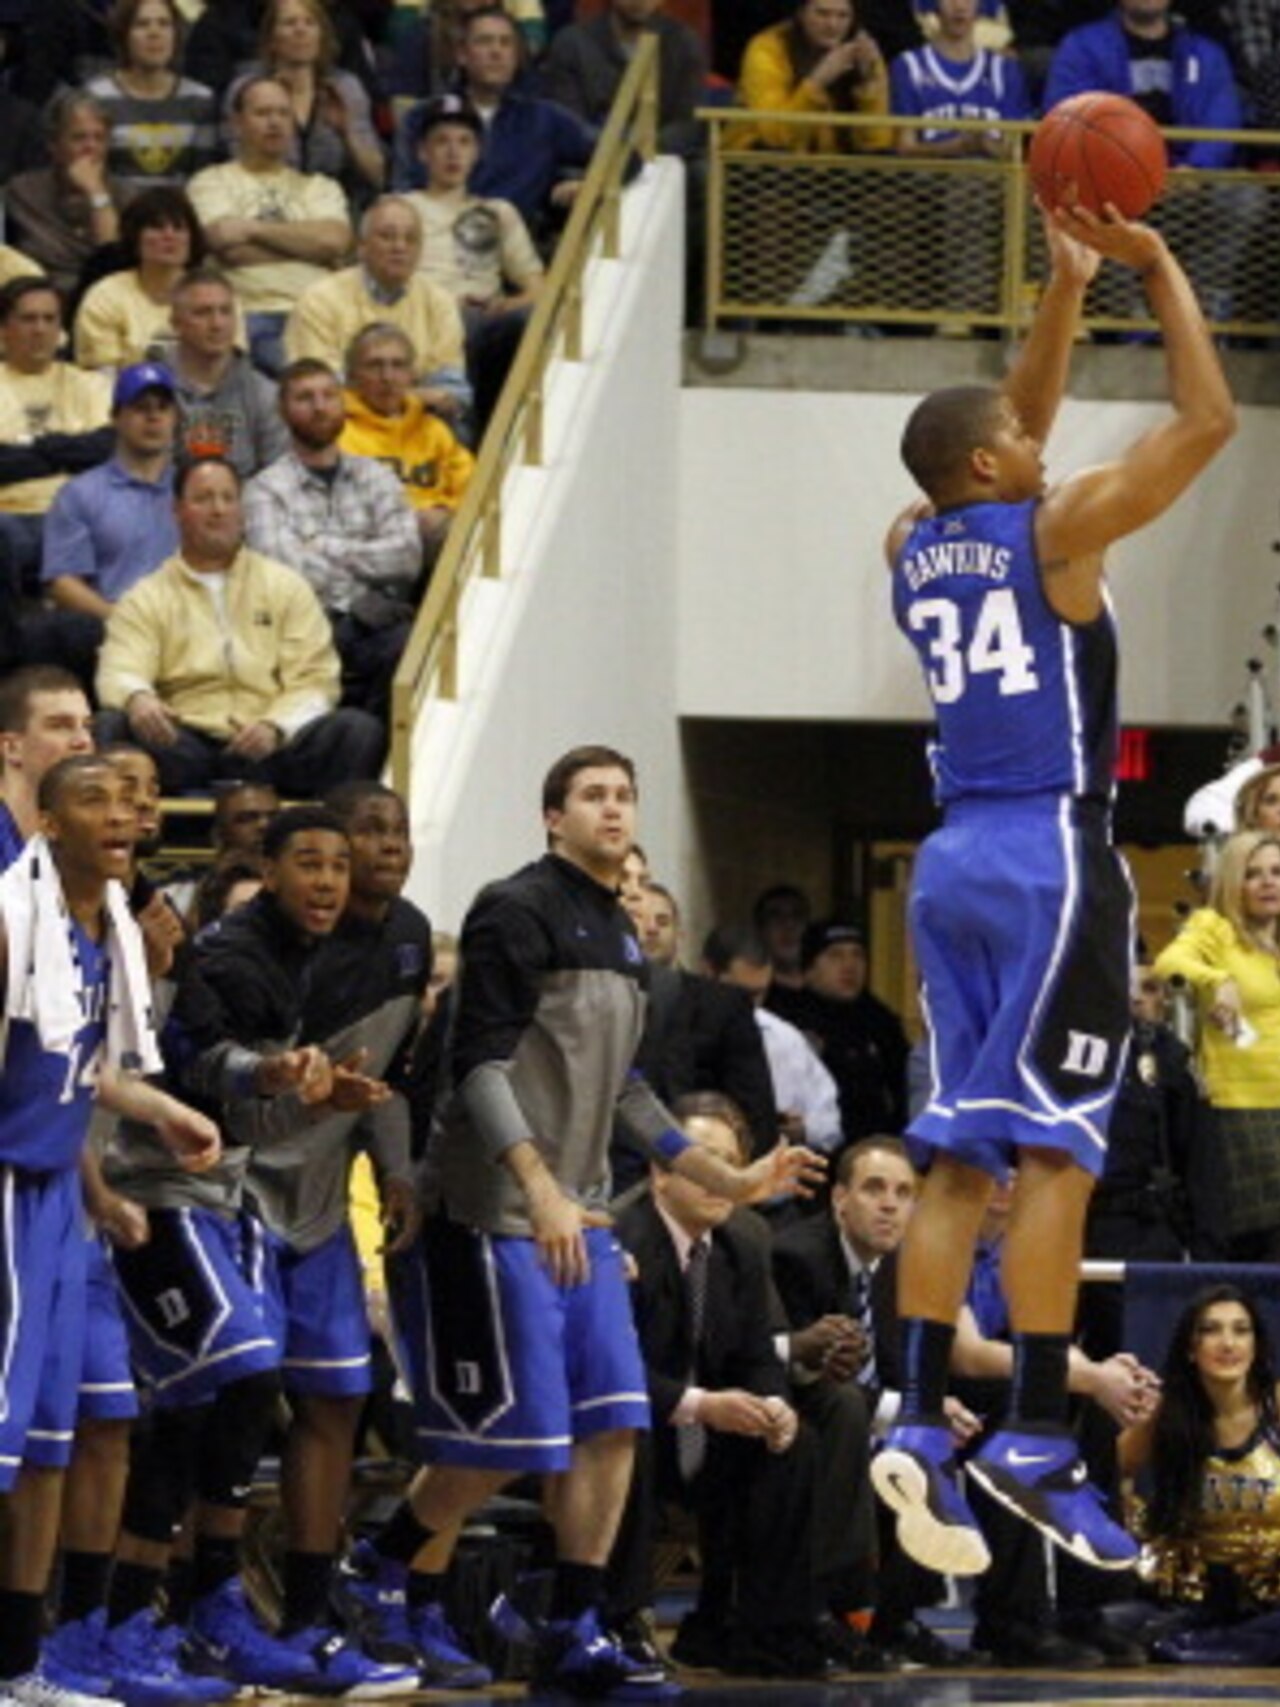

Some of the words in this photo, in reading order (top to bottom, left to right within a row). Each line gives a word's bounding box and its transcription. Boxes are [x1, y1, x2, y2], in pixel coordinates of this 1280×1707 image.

[903, 539, 1012, 592] DAWKINS
[908, 587, 1040, 704] 34
[1059, 1029, 1108, 1078] D
